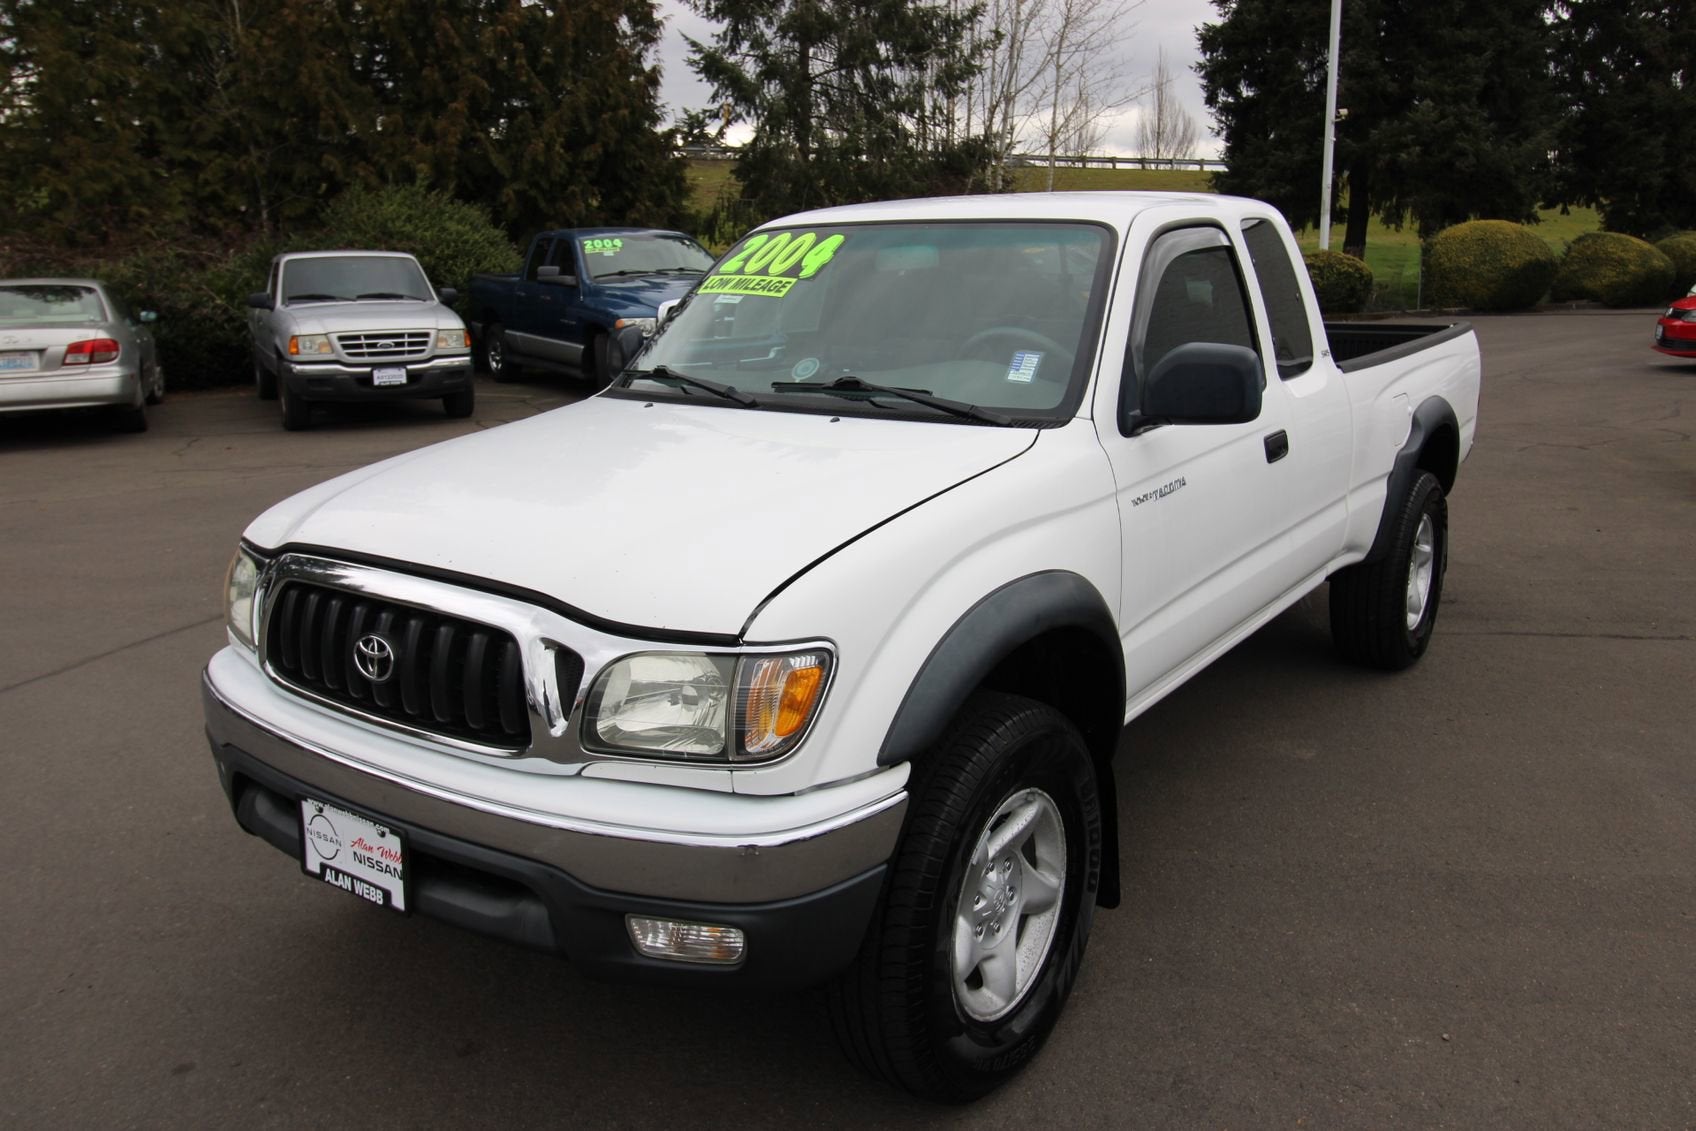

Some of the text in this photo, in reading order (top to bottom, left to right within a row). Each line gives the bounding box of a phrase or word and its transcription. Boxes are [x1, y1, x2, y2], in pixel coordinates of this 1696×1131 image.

[584, 239, 622, 249] 2004
[720, 232, 845, 278] 2004
[703, 278, 793, 294] LOW MILEAGE
[1153, 477, 1186, 500] TACOMA
[307, 827, 341, 847] NISSAN
[351, 837, 374, 853] Alan
[353, 851, 403, 880] NISSAN
[325, 868, 383, 905] ALAN WEBB
